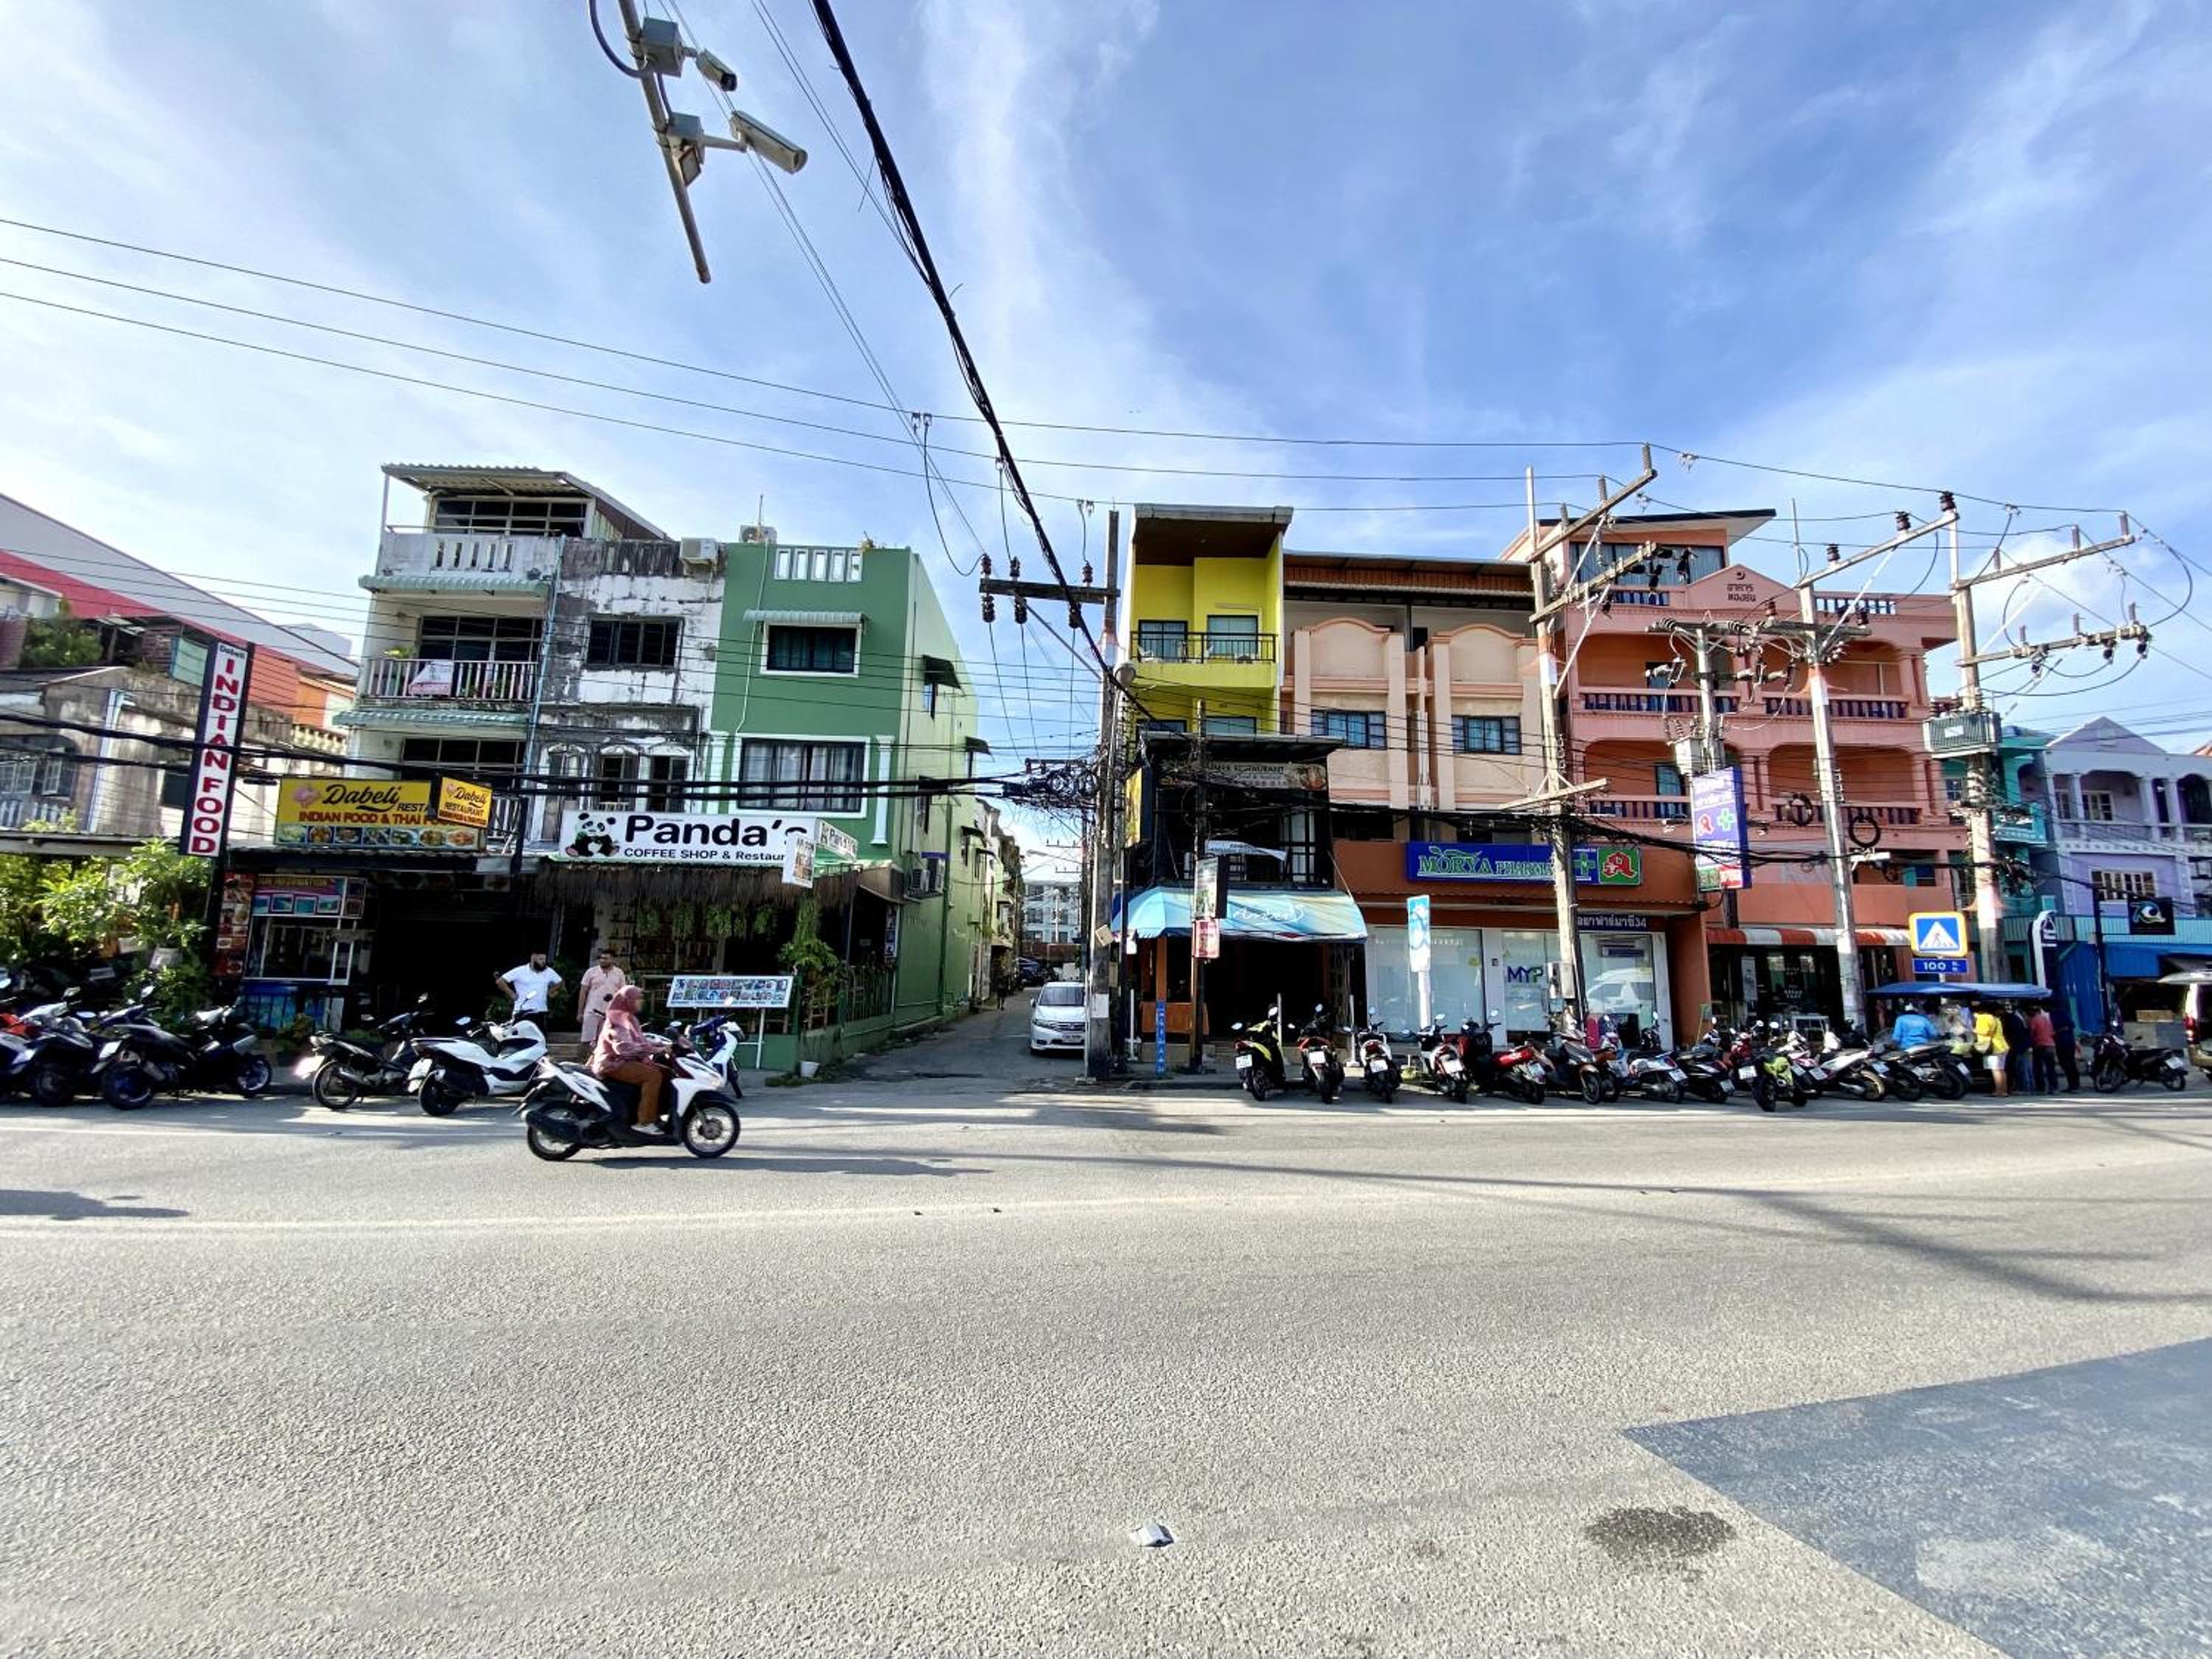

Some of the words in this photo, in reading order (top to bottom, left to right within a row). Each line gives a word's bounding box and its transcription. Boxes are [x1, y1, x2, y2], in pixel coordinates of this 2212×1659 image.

[204, 658, 239, 771] INDIAN
[322, 784, 402, 811] Dabeli
[191, 776, 223, 854] FOOD
[299, 811, 341, 822] INDIAN
[344, 812, 378, 823] FOOD
[381, 813, 390, 824] &
[392, 813, 422, 824] THAI
[624, 847, 677, 858] COFFEE
[680, 849, 717, 859] SHOP
[722, 850, 731, 860] &
[736, 851, 785, 861] Restaur
[1417, 853, 1495, 874] MORYA
[1507, 966, 1543, 983] MYP
[1923, 961, 1947, 971] 100
